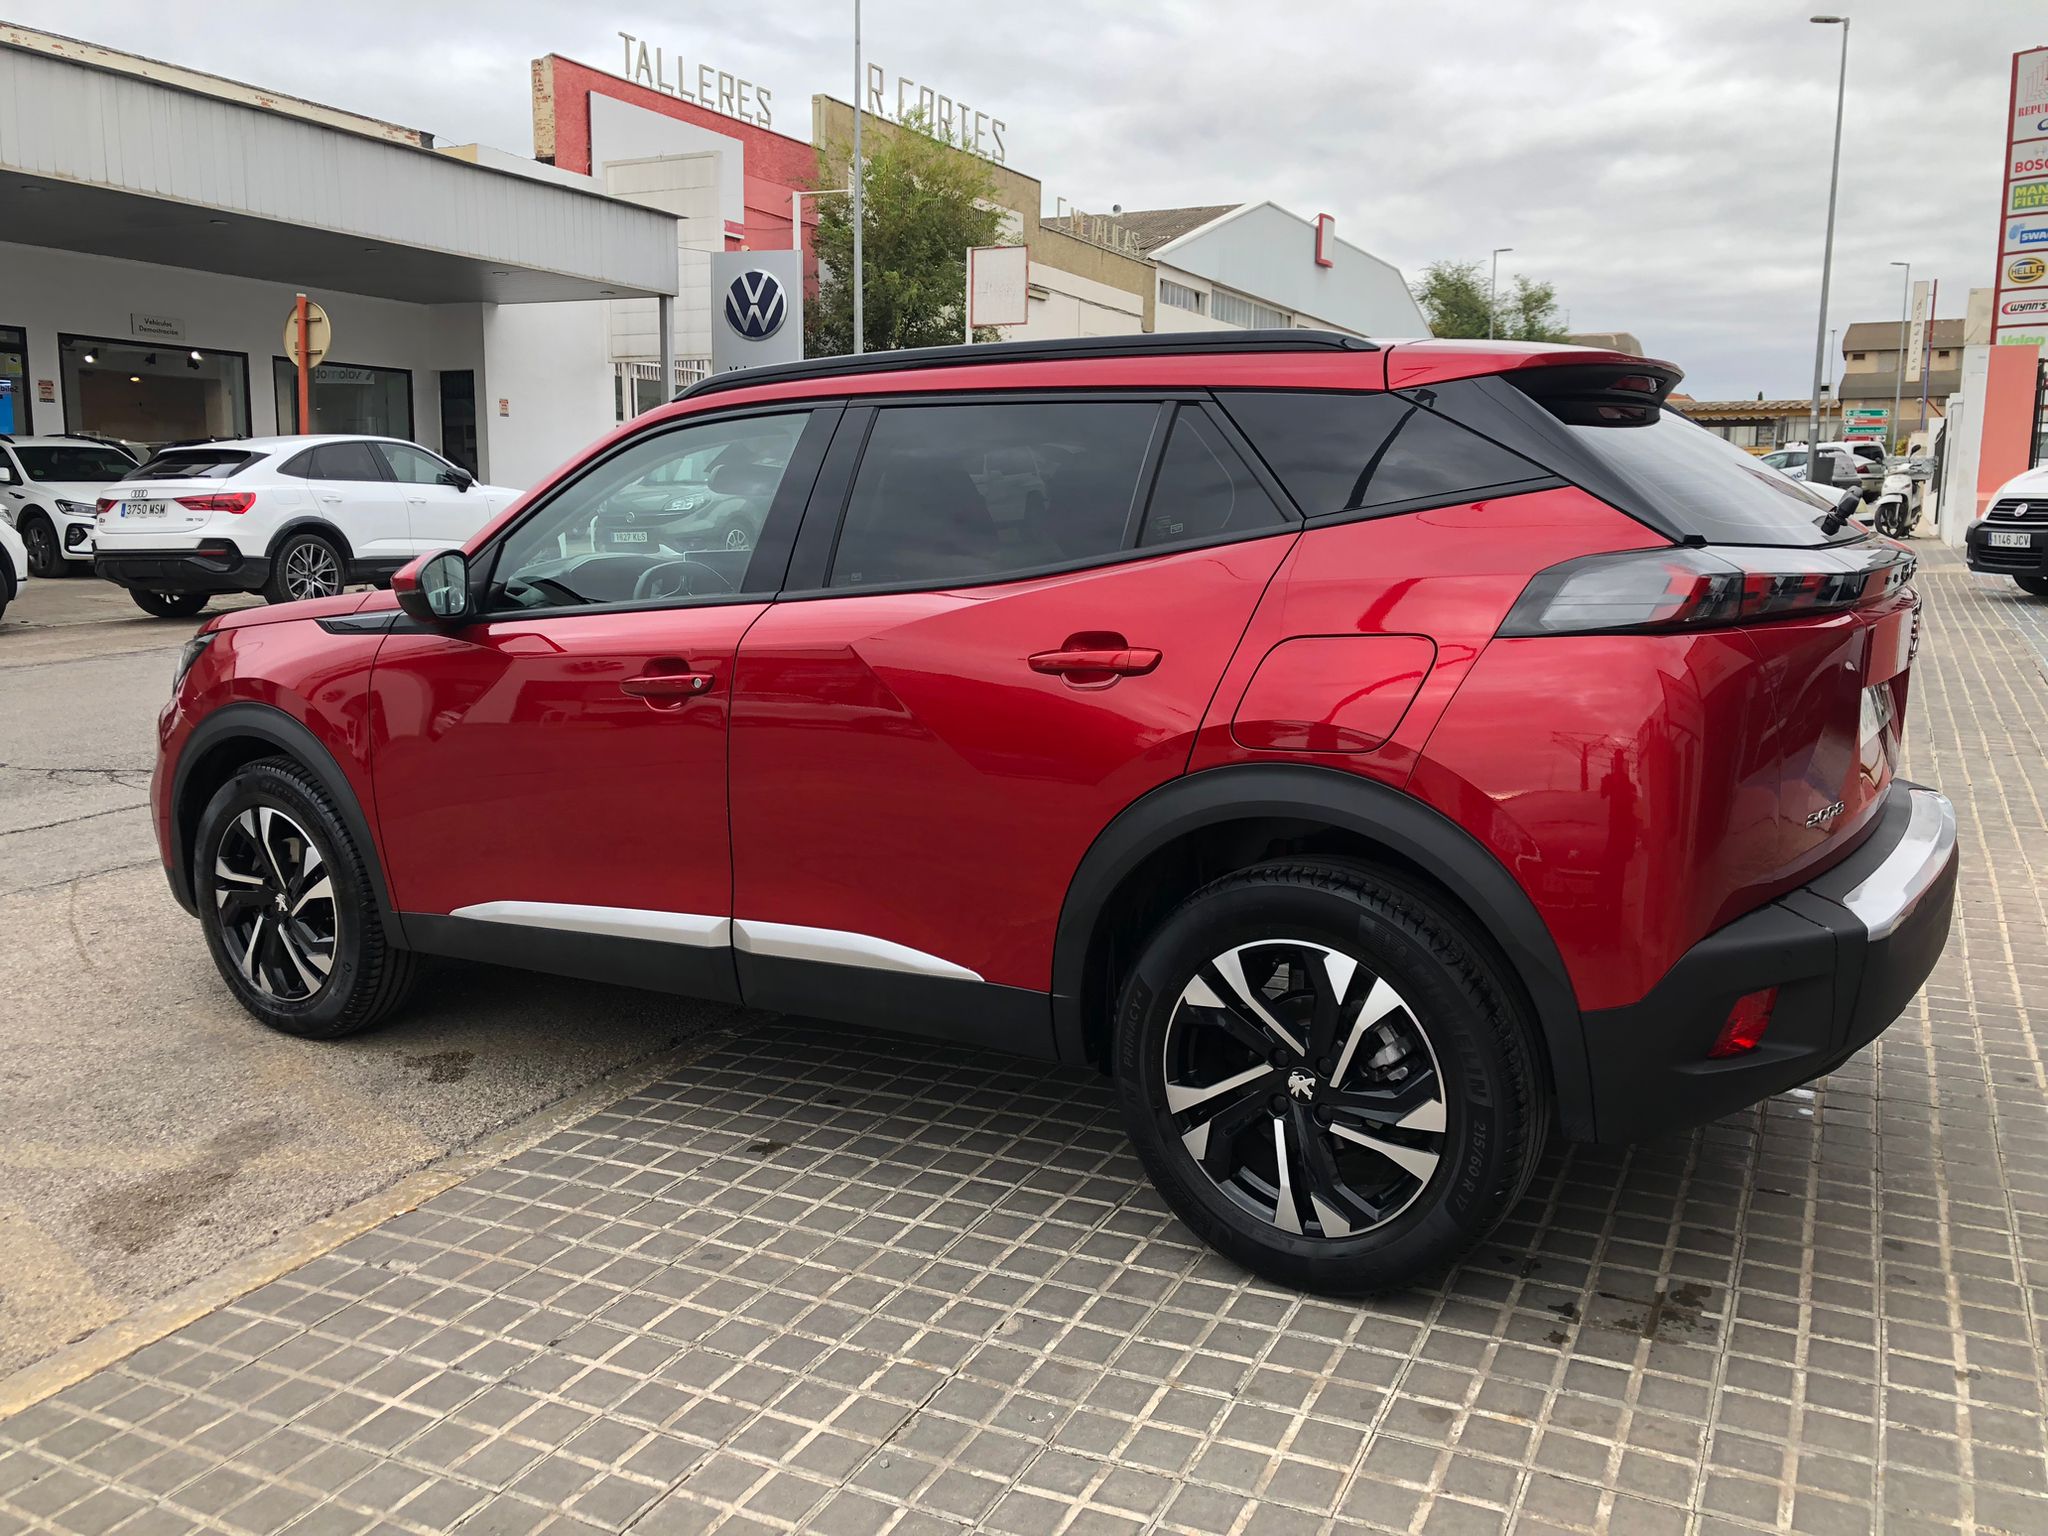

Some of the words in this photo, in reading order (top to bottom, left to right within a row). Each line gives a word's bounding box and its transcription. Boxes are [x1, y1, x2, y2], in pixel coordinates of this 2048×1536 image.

[617, 31, 771, 125] TALLERES
[2021, 231, 2048, 242] SWA
[2011, 265, 2045, 276] HELLA
[126, 504, 147, 515] 3750
[149, 503, 166, 514] MSM
[1993, 534, 2011, 545] 1146
[2013, 535, 2029, 546] JCV
[1123, 997, 1141, 1068] PRIMACY
